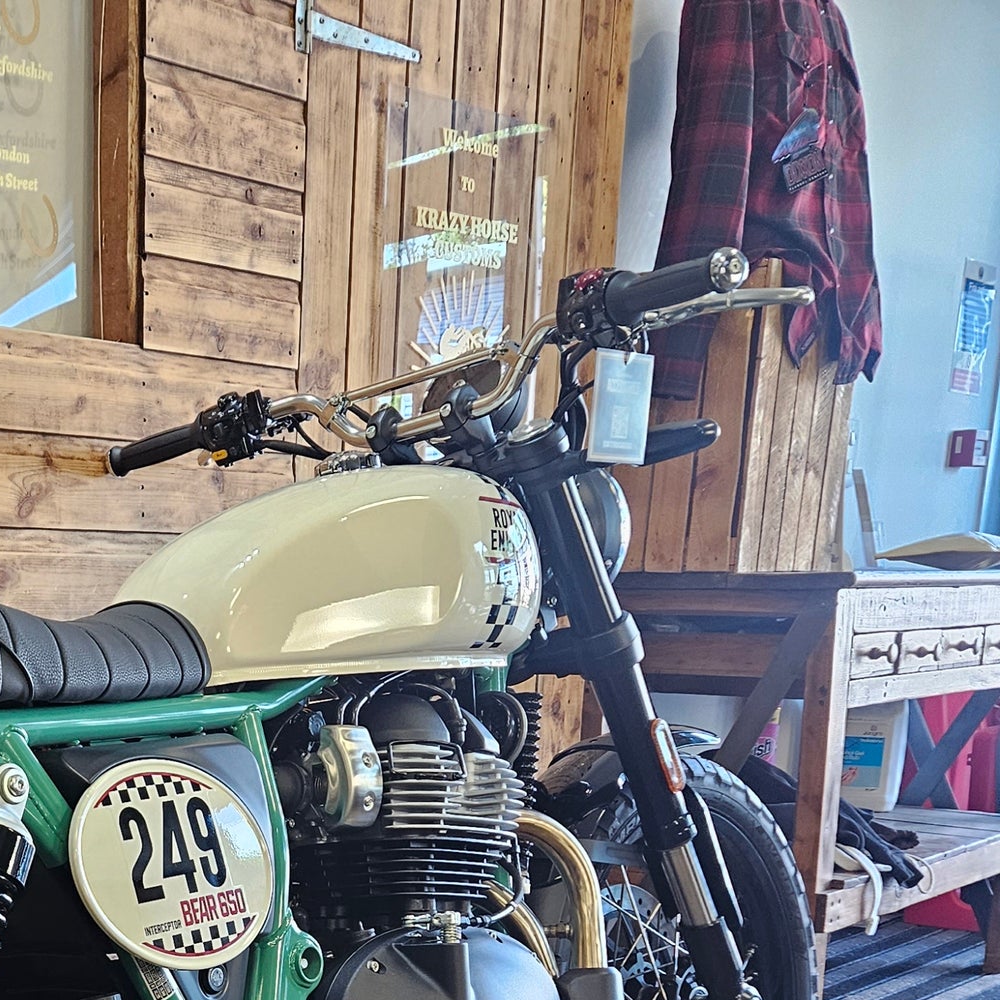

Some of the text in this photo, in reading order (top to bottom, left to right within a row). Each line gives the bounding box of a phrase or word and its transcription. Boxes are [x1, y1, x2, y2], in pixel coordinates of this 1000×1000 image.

[442, 127, 499, 158] Welcome
[5, 172, 38, 191] Street
[416, 206, 519, 244] KRAZY HORSE
[435, 239, 502, 270] CUSTOMS
[118, 796, 227, 904] 249
[180, 887, 247, 927] BEAR 650
[144, 919, 183, 936] INTERCEPTOR
